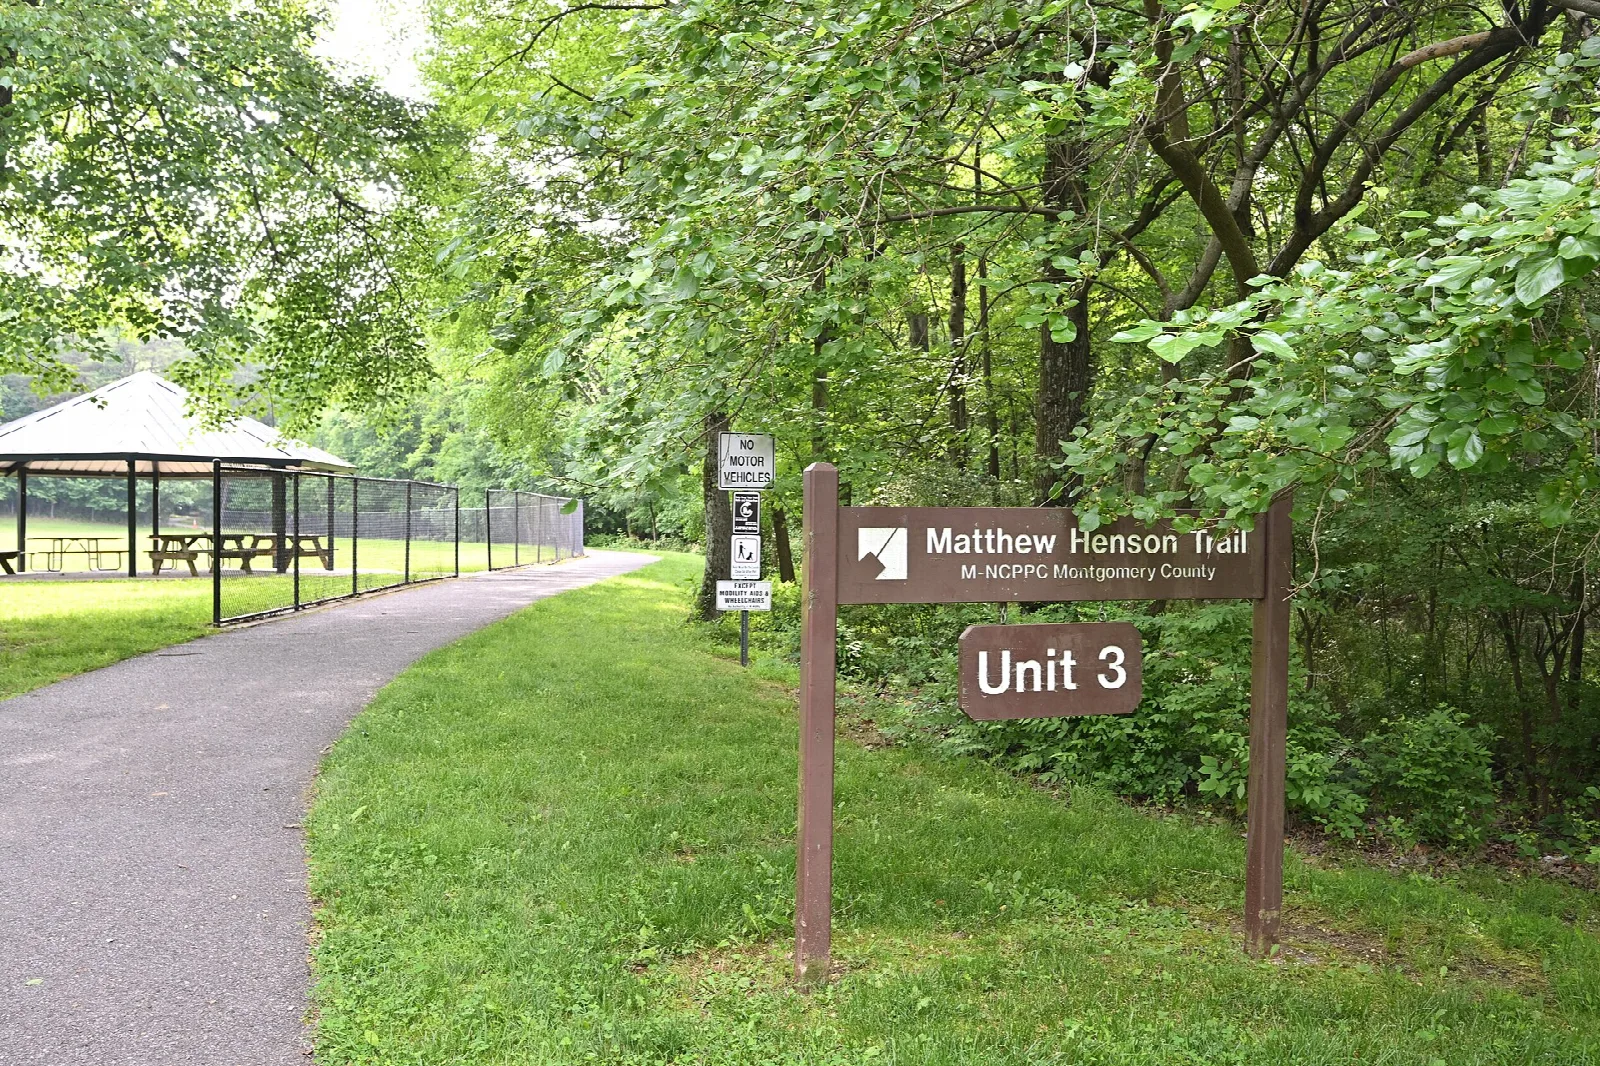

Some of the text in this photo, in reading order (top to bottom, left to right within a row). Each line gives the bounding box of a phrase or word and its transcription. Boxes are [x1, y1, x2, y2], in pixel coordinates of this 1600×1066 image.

[740, 439, 754, 450] NO
[729, 456, 765, 467] MOTOR
[723, 471, 771, 482] VEHICLES
[926, 527, 1248, 554] Matthew Henson Trail
[961, 563, 1216, 582] M-NCPPC Montgomery County
[977, 645, 1127, 695] Unit 3
